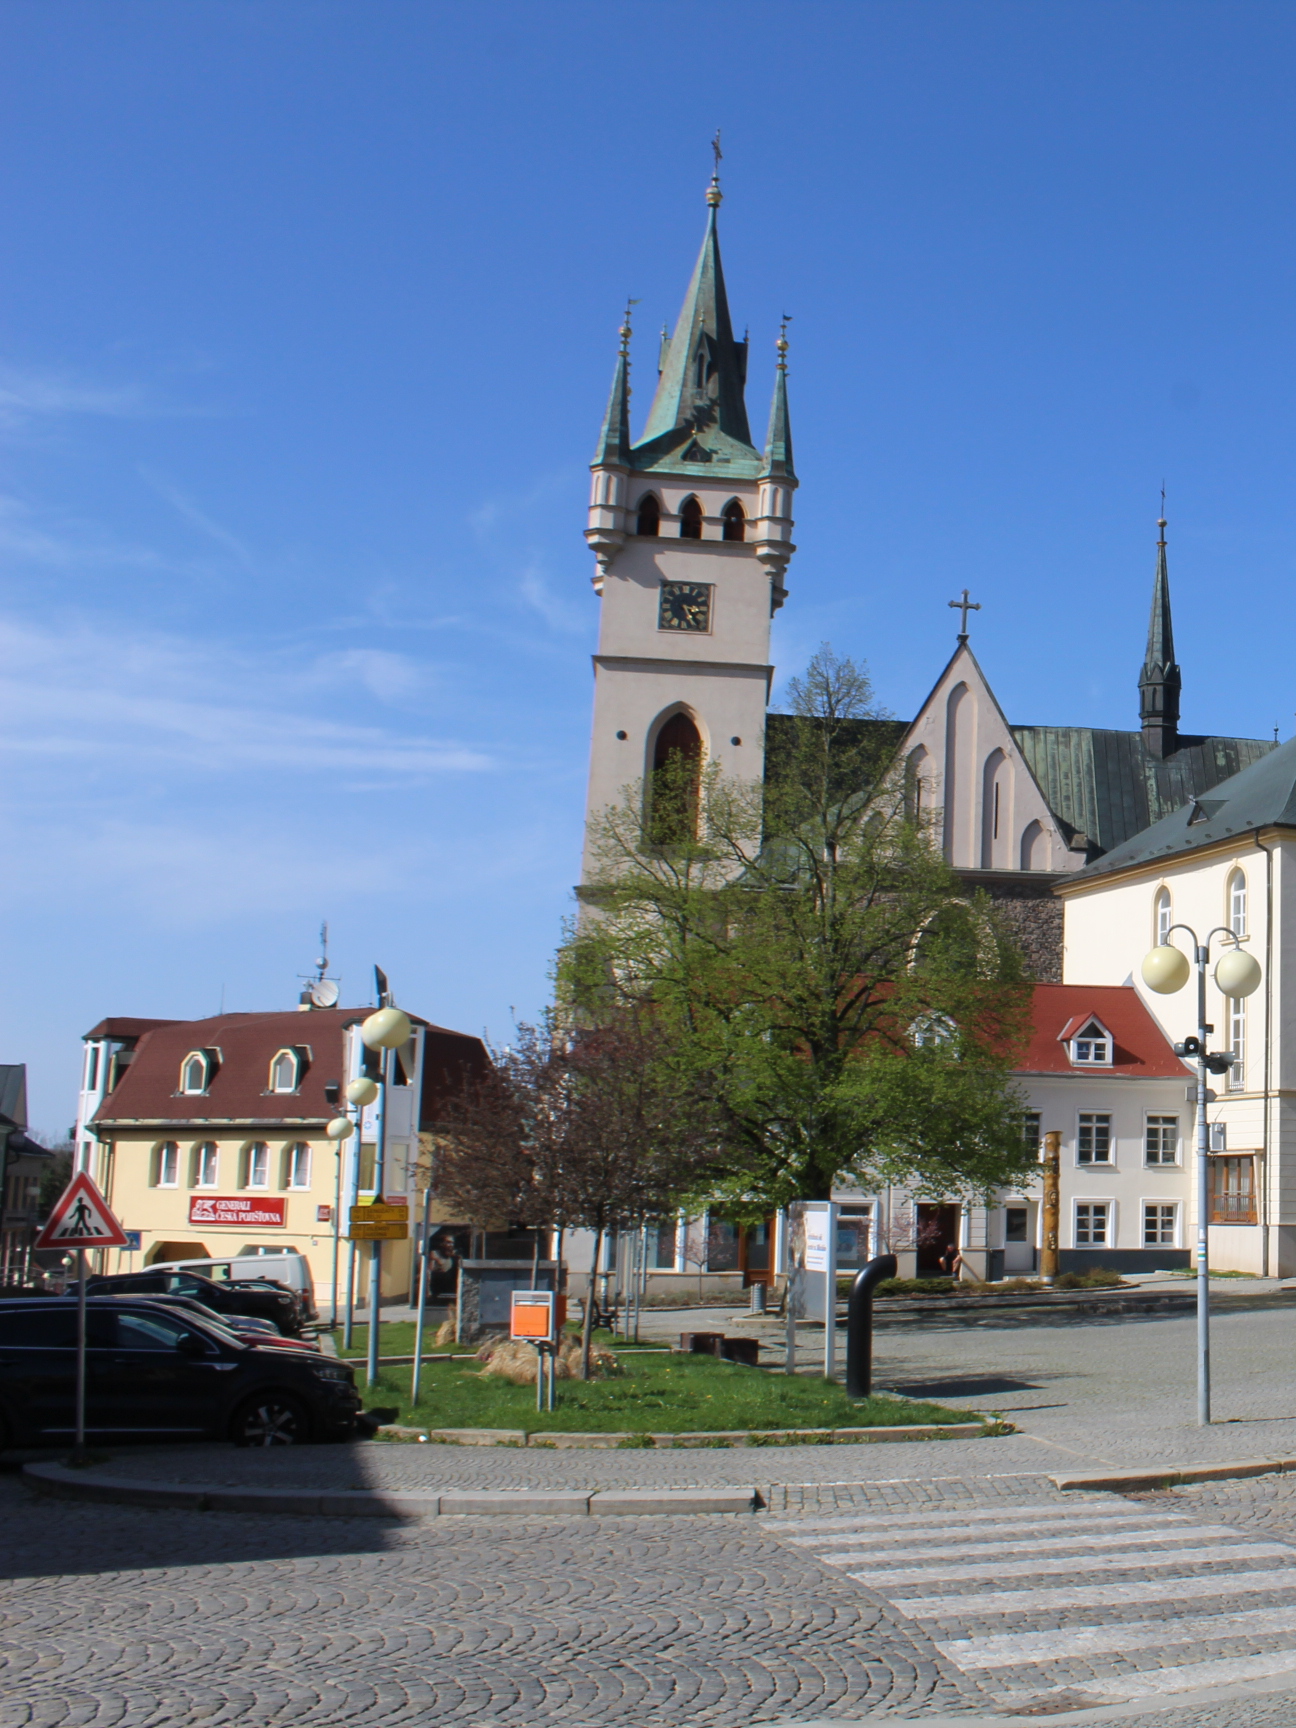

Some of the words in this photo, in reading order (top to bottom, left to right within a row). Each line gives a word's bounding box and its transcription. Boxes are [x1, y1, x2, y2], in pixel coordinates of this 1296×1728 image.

[216, 1200, 251, 1210] GENERALI
[215, 1209, 238, 1221] ČESKÁ
[238, 1210, 281, 1222] POJIŠŤOVNA
